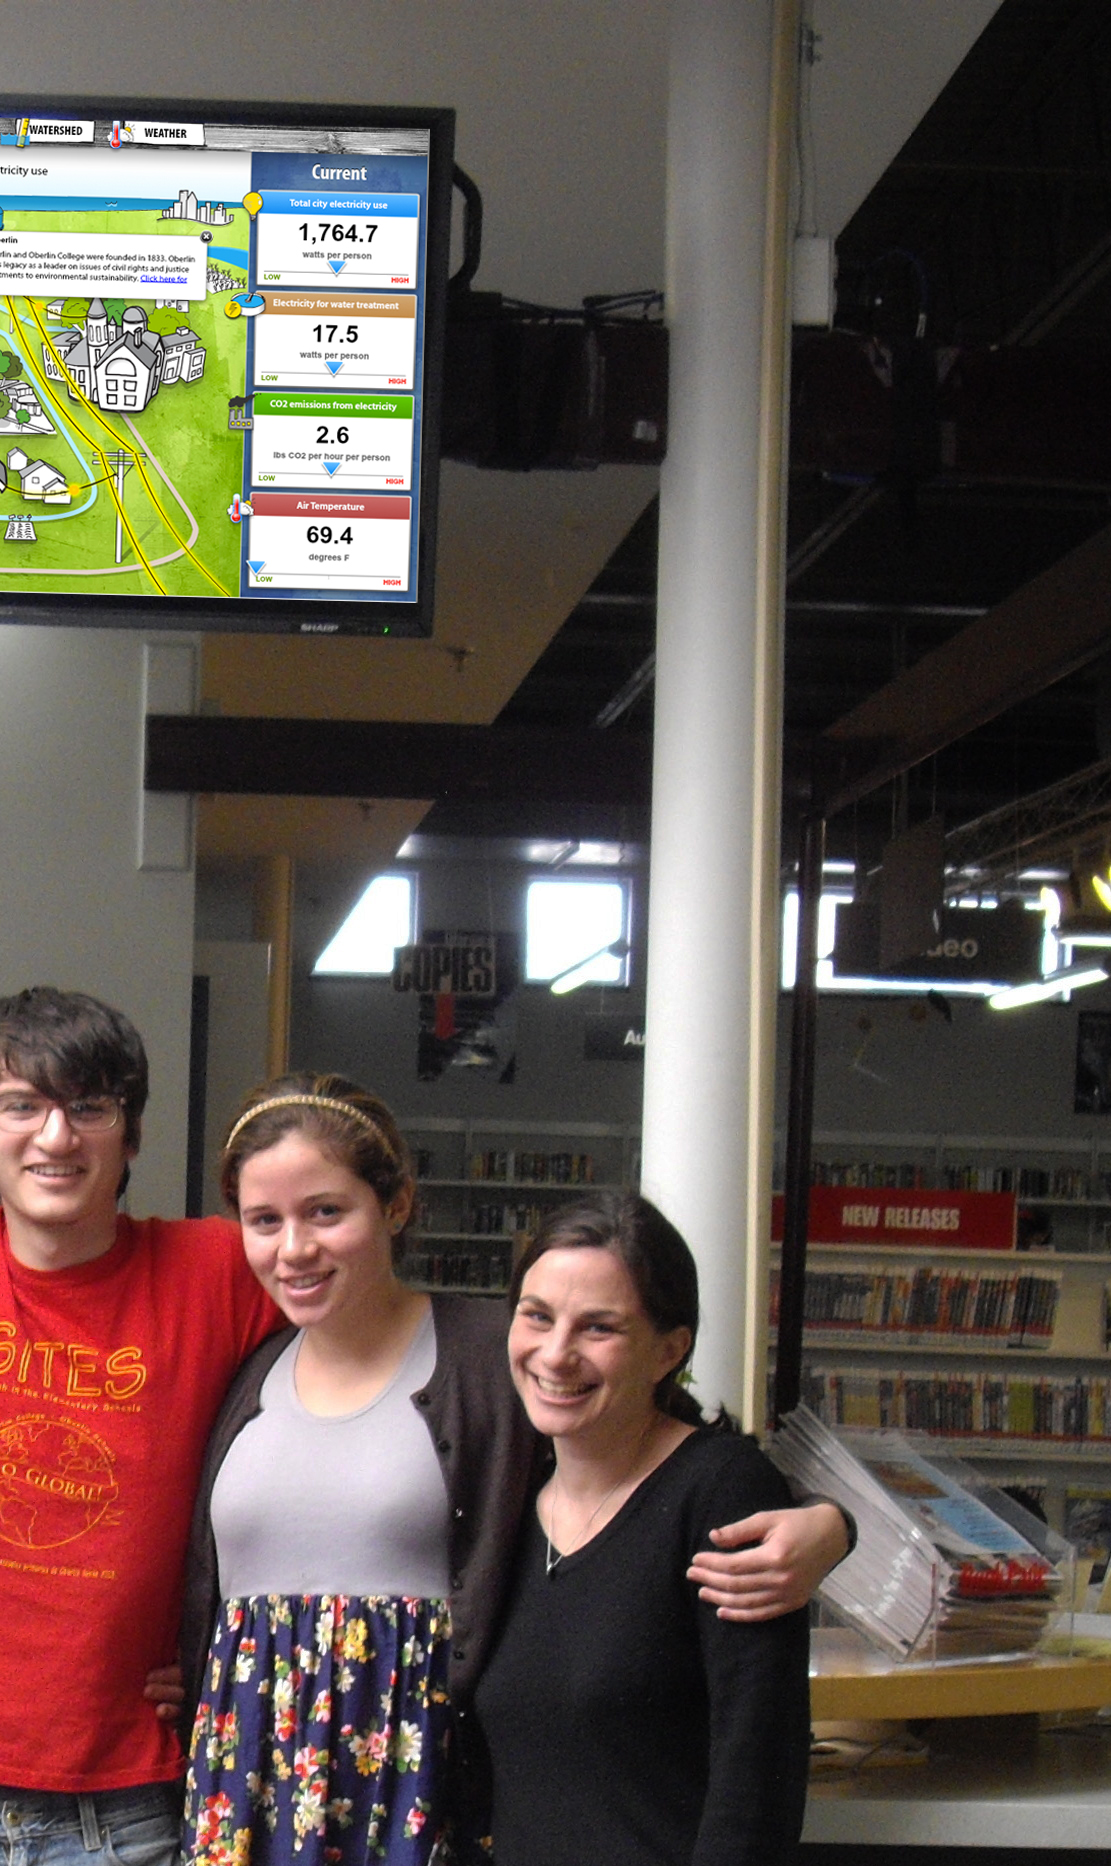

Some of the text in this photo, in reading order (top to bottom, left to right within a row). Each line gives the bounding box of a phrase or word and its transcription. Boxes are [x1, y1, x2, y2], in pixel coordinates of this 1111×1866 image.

[30, 125, 82, 136] WATERSHED
[144, 128, 186, 138] WEATHER
[31, 168, 48, 176] use
[312, 163, 368, 181] Current
[290, 199, 388, 211] Total city electricity use
[298, 223, 378, 244] 1,764.7
[28, 251, 56, 259] Oberlin
[57, 252, 85, 261] College
[105, 253, 137, 261] founded
[168, 255, 196, 263] Oberlin
[302, 251, 372, 262] watts per person
[3, 261, 27, 270] legacy
[43, 262, 66, 270] leader
[127, 265, 148, 273] rights
[89, 274, 139, 282] sustainability.
[140, 275, 158, 283] Click
[159, 275, 176, 283] here
[177, 276, 188, 284] for
[273, 299, 399, 310] Electricity for water treatment
[312, 324, 358, 343] 17.5
[300, 351, 370, 361] watts per person
[270, 400, 397, 412] CO2 emissions from electricity
[316, 426, 350, 444] 2.6
[273, 451, 286, 459] lbs
[288, 452, 306, 460] CO2
[324, 452, 343, 461] hour
[361, 455, 391, 463] person
[296, 501, 365, 512] Air Temperature
[306, 526, 353, 545] 69.4
[308, 553, 342, 562] degrees
[394, 946, 494, 993] COPIES
[842, 1206, 960, 1231] NEW RELEASES
[26, 1468, 103, 1502] GLOBAL!
